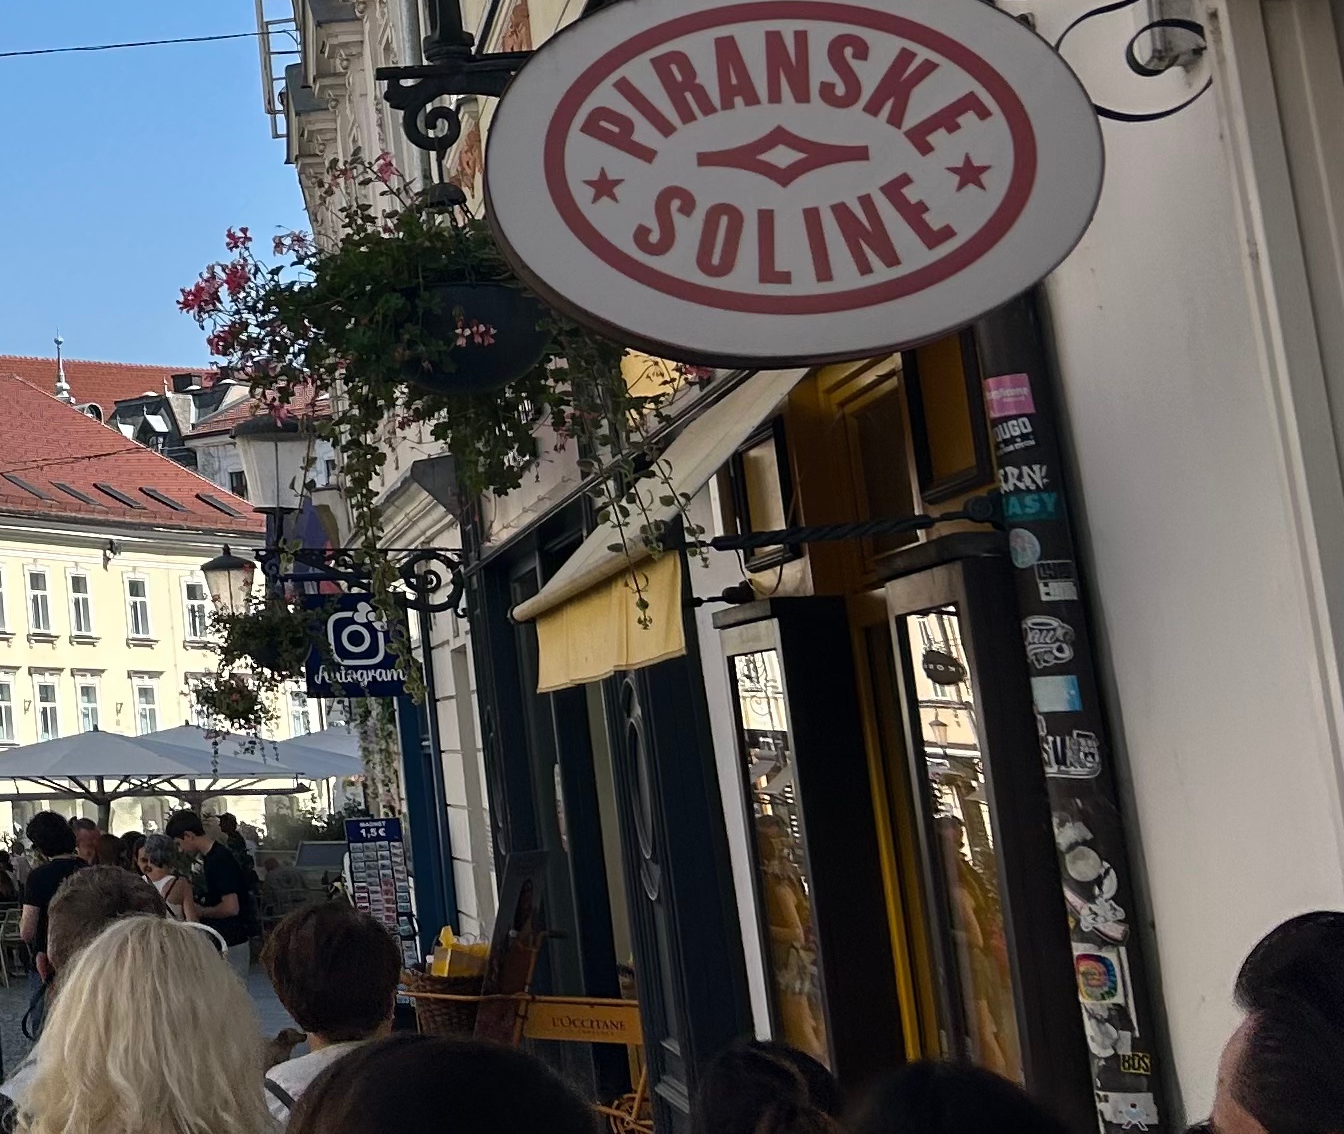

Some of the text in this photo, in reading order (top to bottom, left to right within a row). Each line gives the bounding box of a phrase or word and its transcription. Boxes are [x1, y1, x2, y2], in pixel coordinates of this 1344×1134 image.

[579, 29, 993, 164] PIRANSKE
[633, 172, 957, 284] SOLINE
[1003, 492, 1057, 516] ASY
[552, 1015, 626, 1031] L'OCCITANE
